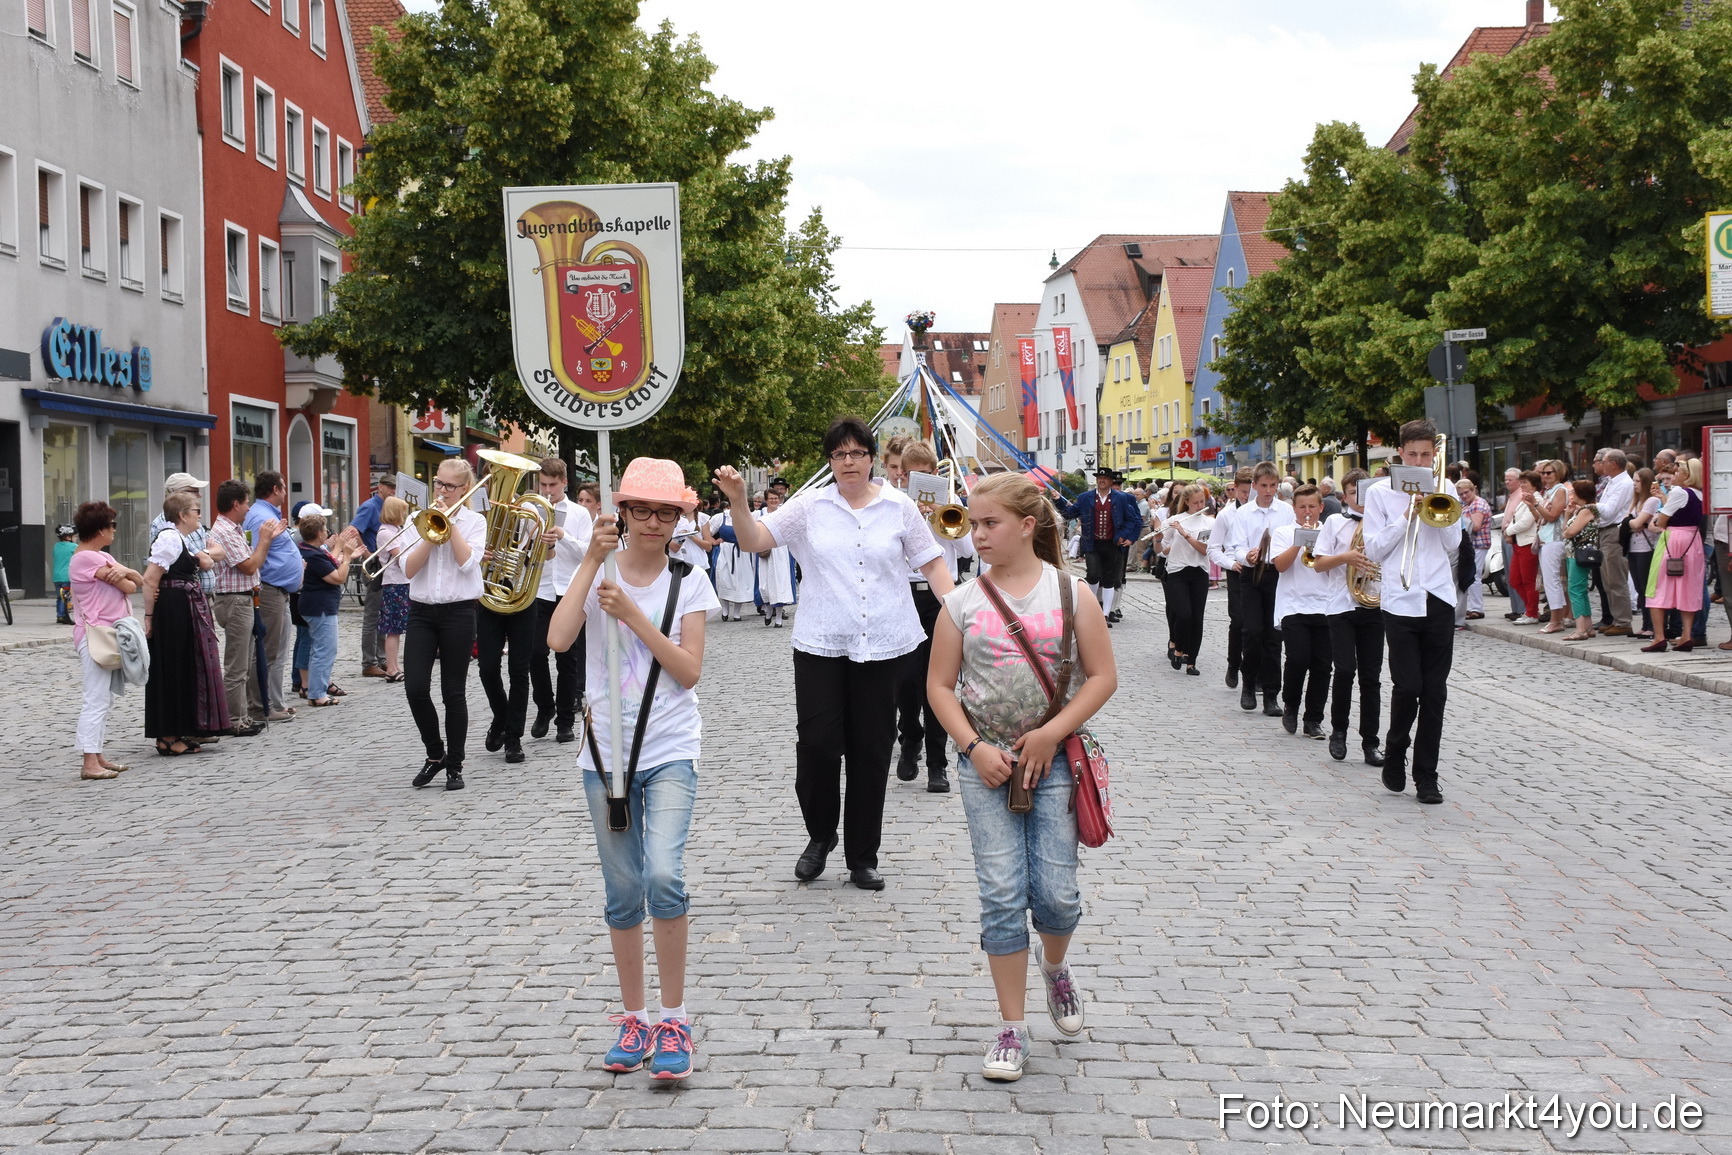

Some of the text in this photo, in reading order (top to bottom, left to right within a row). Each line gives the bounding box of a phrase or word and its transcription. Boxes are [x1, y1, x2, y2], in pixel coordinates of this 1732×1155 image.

[517, 215, 671, 239] Jugendblaskapelle
[45, 317, 132, 389] Eilles
[1055, 330, 1066, 356] K&L
[534, 362, 669, 420] Seubersdorf
